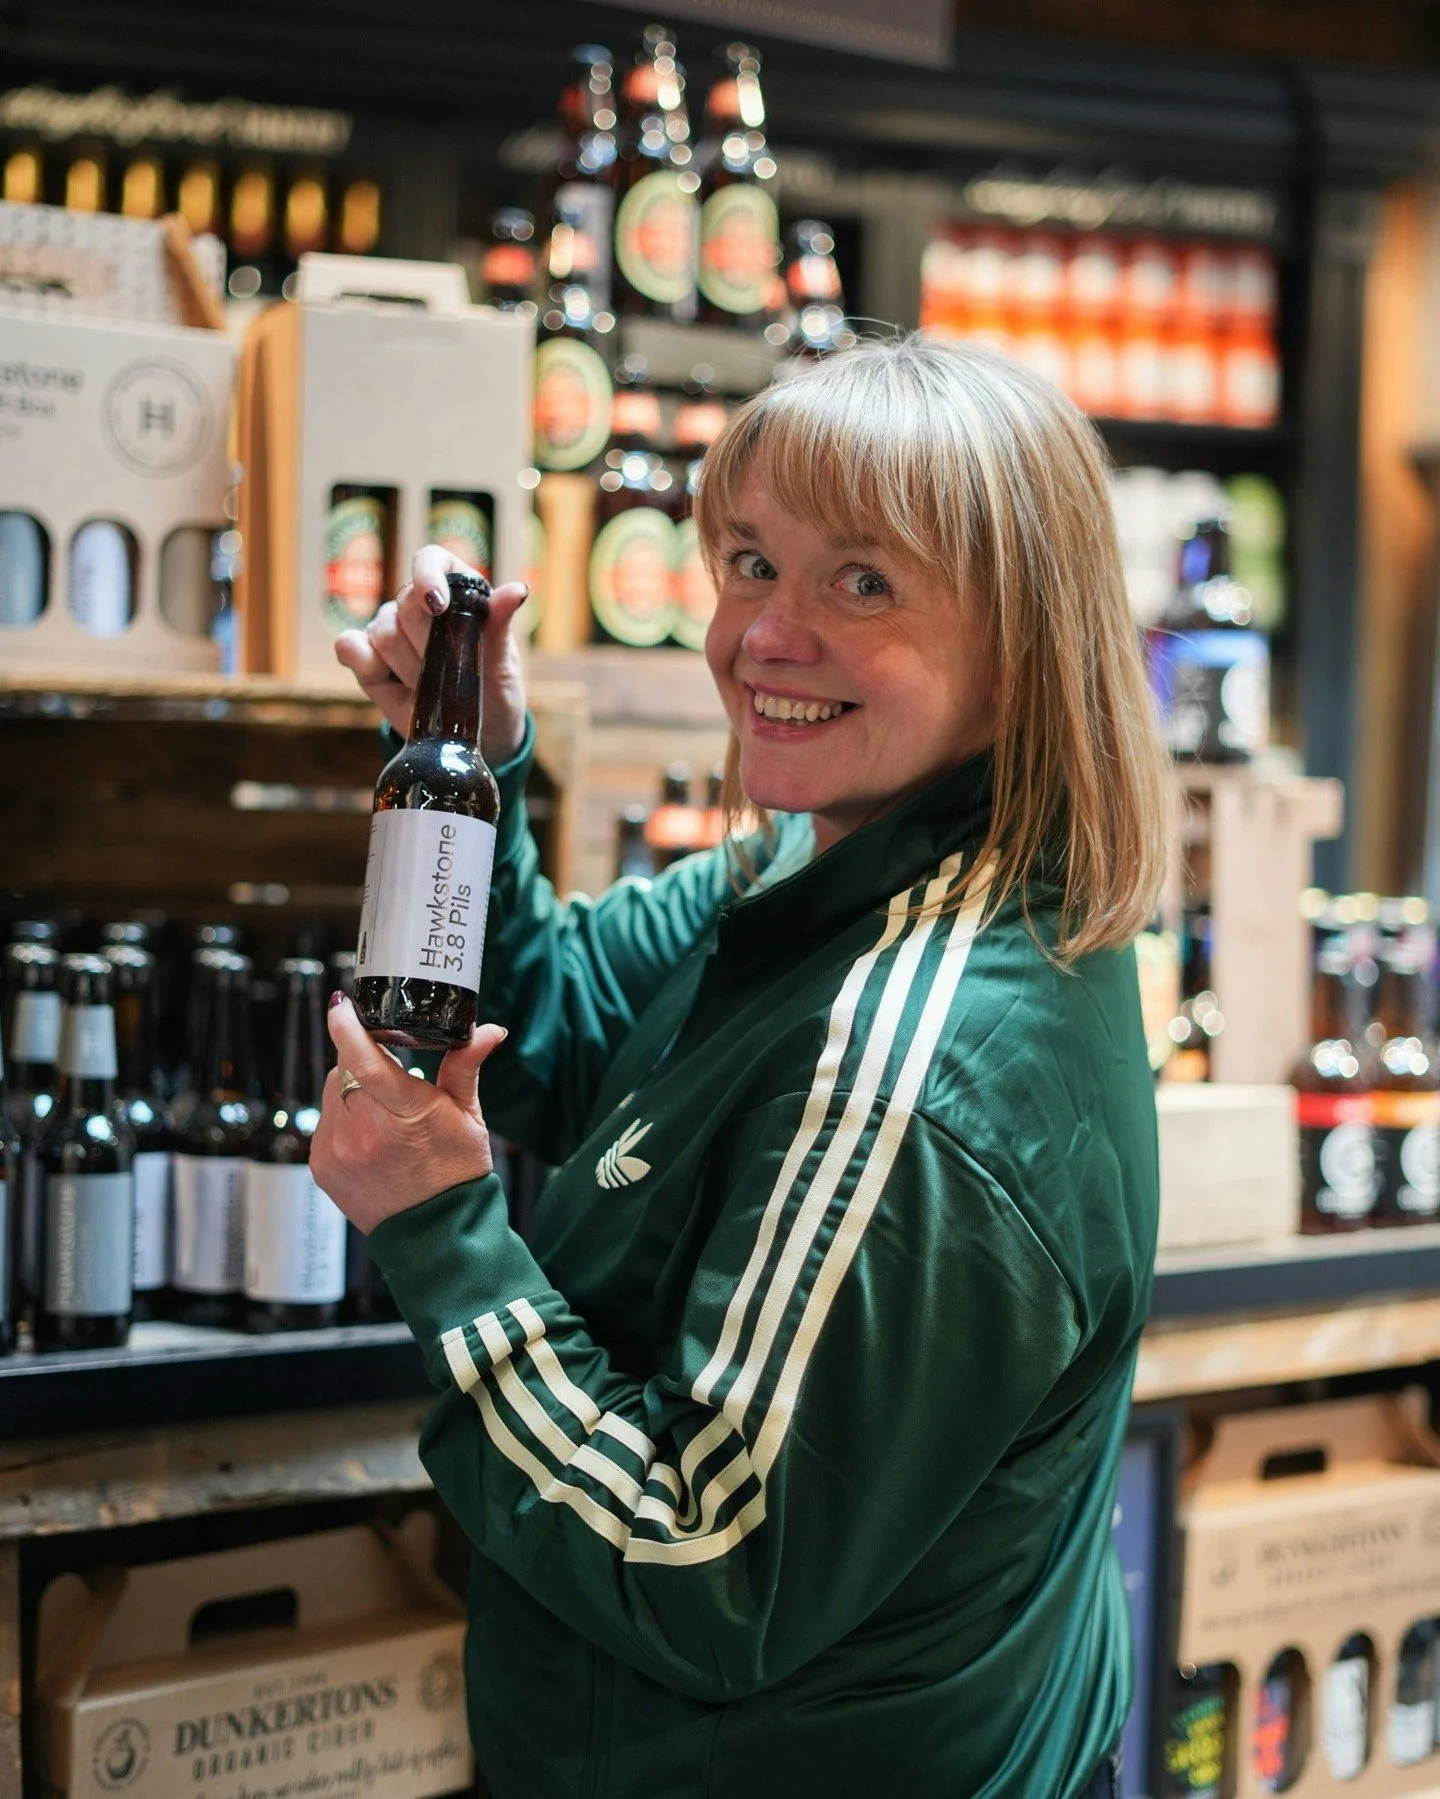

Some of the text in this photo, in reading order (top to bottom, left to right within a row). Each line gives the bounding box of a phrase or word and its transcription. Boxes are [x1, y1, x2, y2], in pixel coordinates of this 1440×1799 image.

[419, 824, 457, 969] Hawkstone
[443, 884, 471, 972] 3.8 Pils
[175, 1674, 399, 1755] DUNKERTONS
[192, 1735, 297, 1781] ORGANIC
